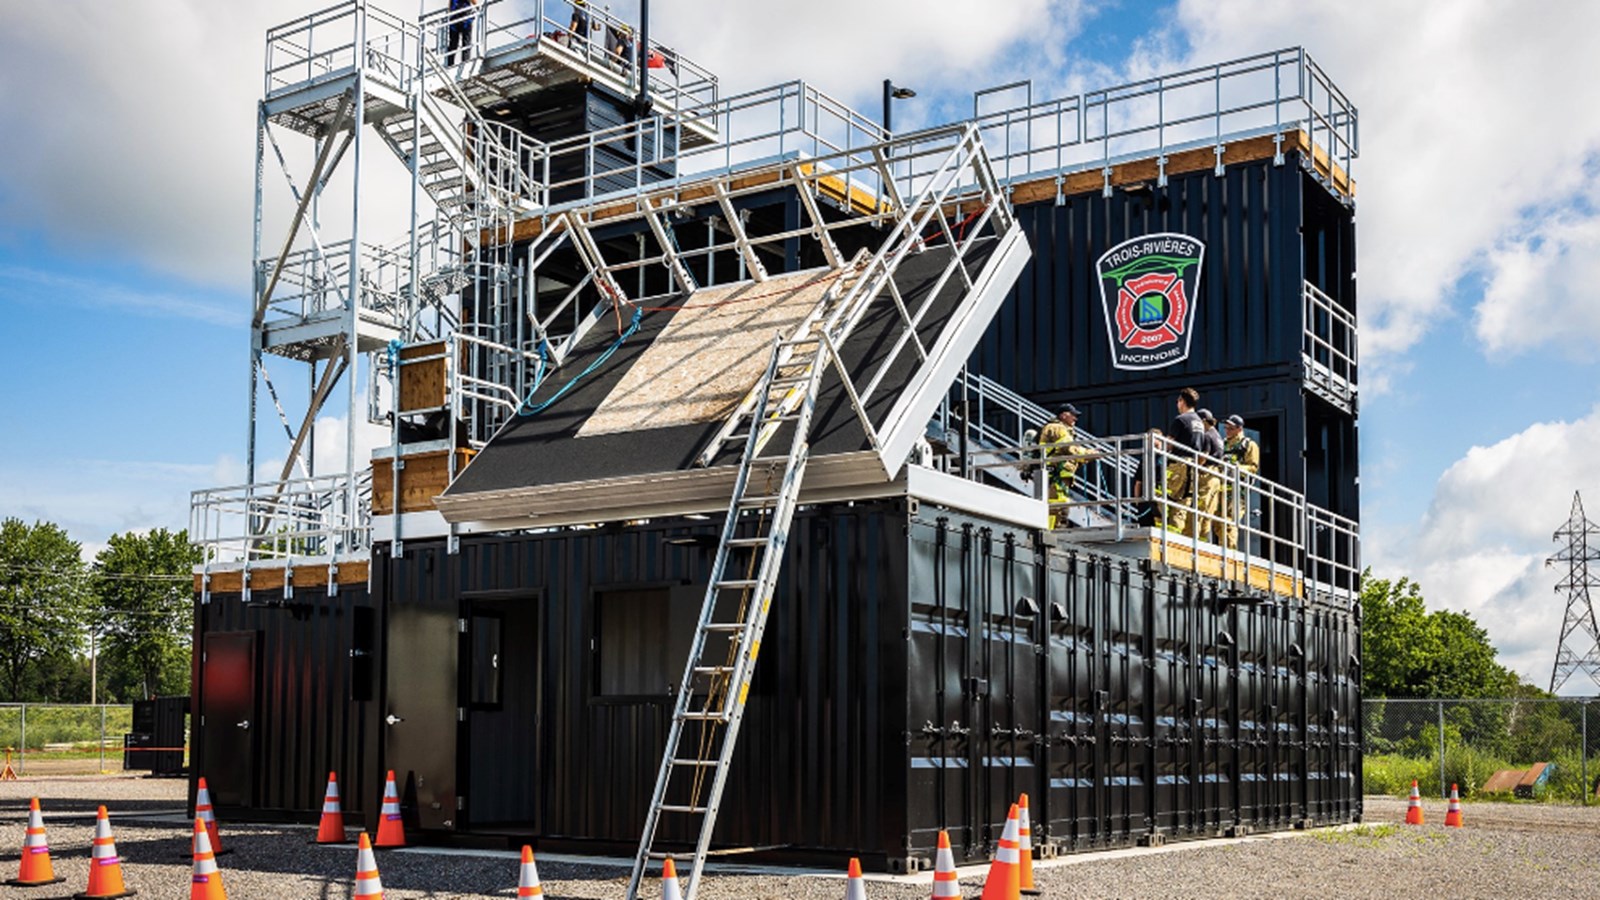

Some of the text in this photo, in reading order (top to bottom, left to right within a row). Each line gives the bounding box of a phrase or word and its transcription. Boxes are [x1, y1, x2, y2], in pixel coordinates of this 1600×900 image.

[1105, 237, 1195, 267] TROIS-RIVIÈRES
[1140, 334, 1163, 344] 2007
[1120, 347, 1180, 362] INCENDIE
